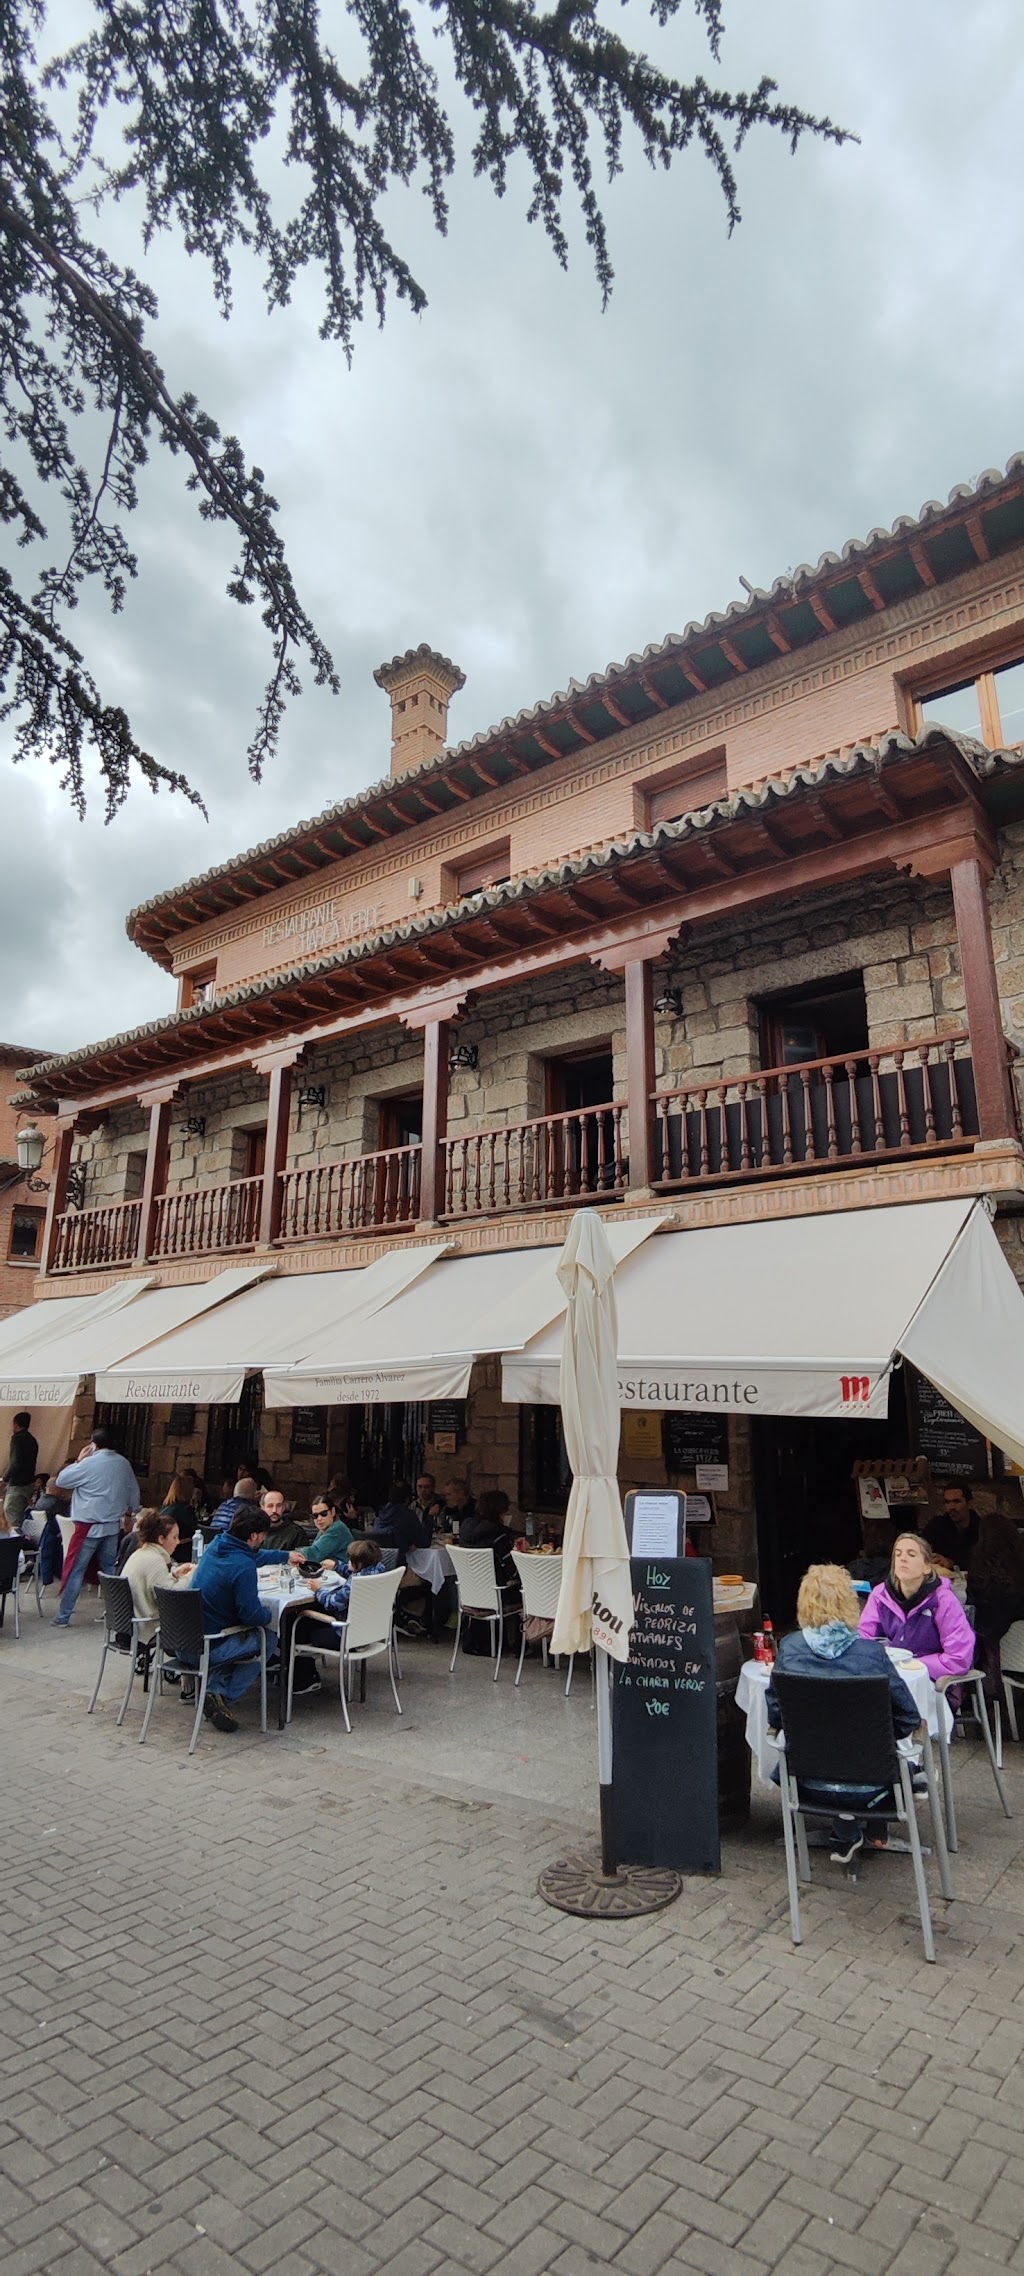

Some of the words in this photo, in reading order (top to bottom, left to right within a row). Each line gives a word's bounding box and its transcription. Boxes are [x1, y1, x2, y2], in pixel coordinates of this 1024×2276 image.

[262, 898, 338, 948] RESTAURANTE
[342, 902, 384, 935] VERDE
[125, 1380, 200, 1398] Restaurante
[314, 1376, 342, 1387] Familia
[343, 1374, 373, 1384] Carrero
[0, 1385, 30, 1401] Charca
[34, 1384, 60, 1402] Verde
[337, 1391, 359, 1402] desde
[361, 1389, 380, 1400] 1972
[617, 1378, 759, 1404] staurante
[592, 1592, 624, 1634] hou
[682, 1605, 695, 1617] DE
[631, 1620, 639, 1630] A
[594, 1627, 613, 1646] 890
[629, 1631, 683, 1651] ATURALES
[684, 1661, 701, 1675] EN
[619, 1667, 632, 1686] LA
[674, 1678, 706, 1692] VERDE
